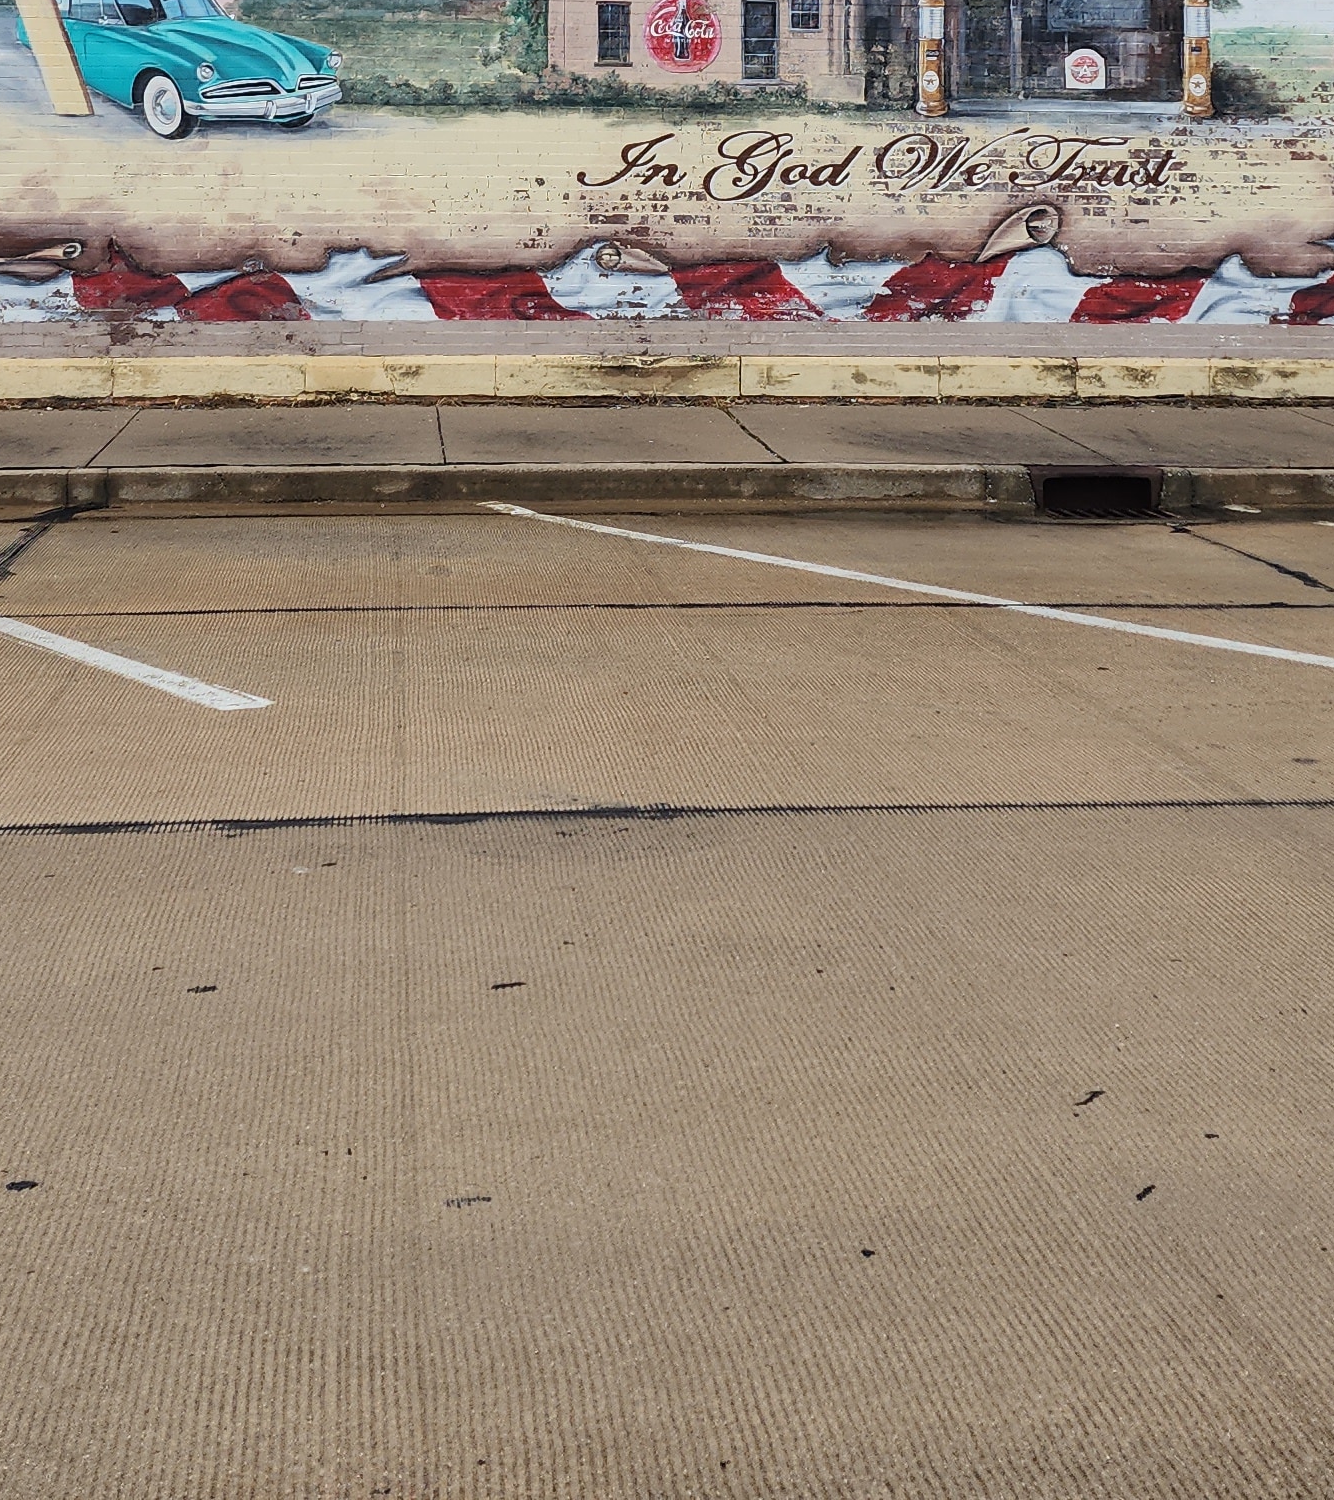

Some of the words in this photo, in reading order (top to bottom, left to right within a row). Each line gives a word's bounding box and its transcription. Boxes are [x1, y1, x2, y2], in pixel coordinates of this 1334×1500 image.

[576, 132, 688, 188] In
[702, 130, 861, 201] God
[875, 126, 1034, 191] We
[1008, 134, 1177, 190] Trust
